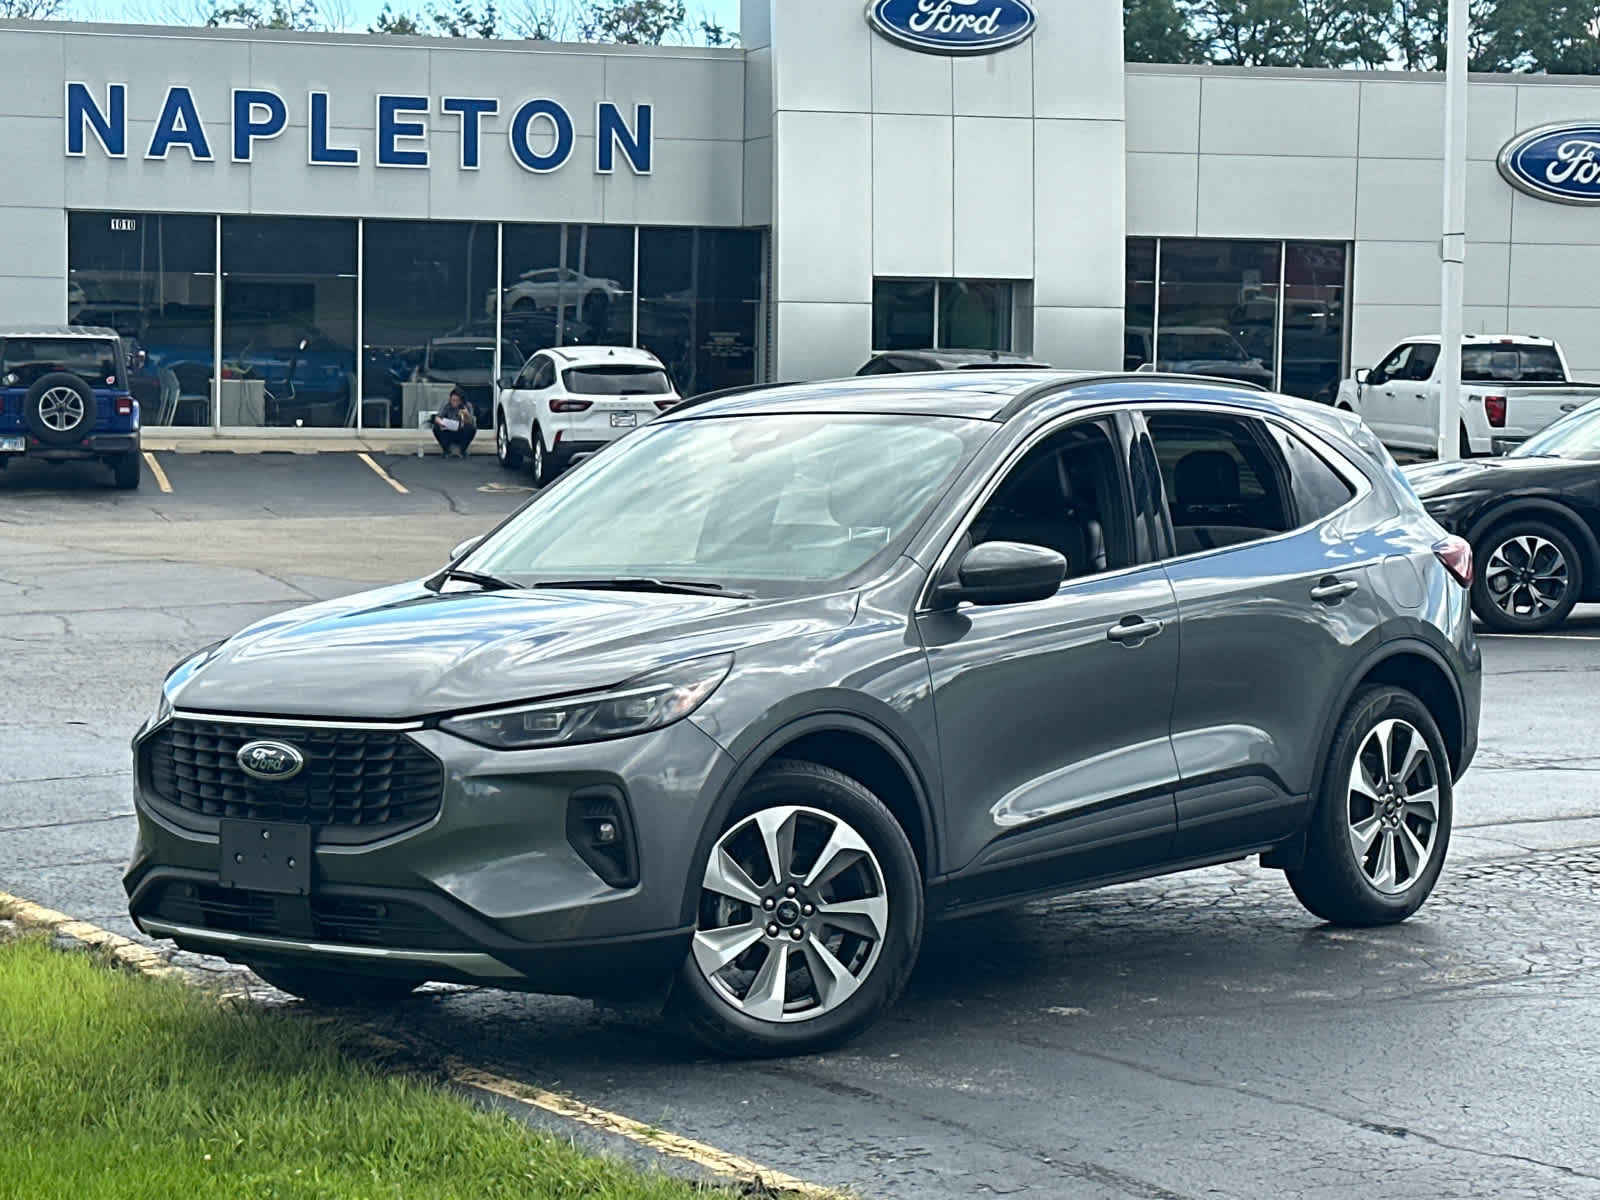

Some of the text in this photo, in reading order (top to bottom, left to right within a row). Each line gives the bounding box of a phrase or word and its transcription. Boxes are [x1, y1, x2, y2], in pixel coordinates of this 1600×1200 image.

[909, 0, 1002, 34] Ford
[65, 81, 653, 175] NAPLETON
[1545, 140, 1600, 183] Fo
[111, 219, 136, 230] 1010
[250, 748, 285, 770] Ford
